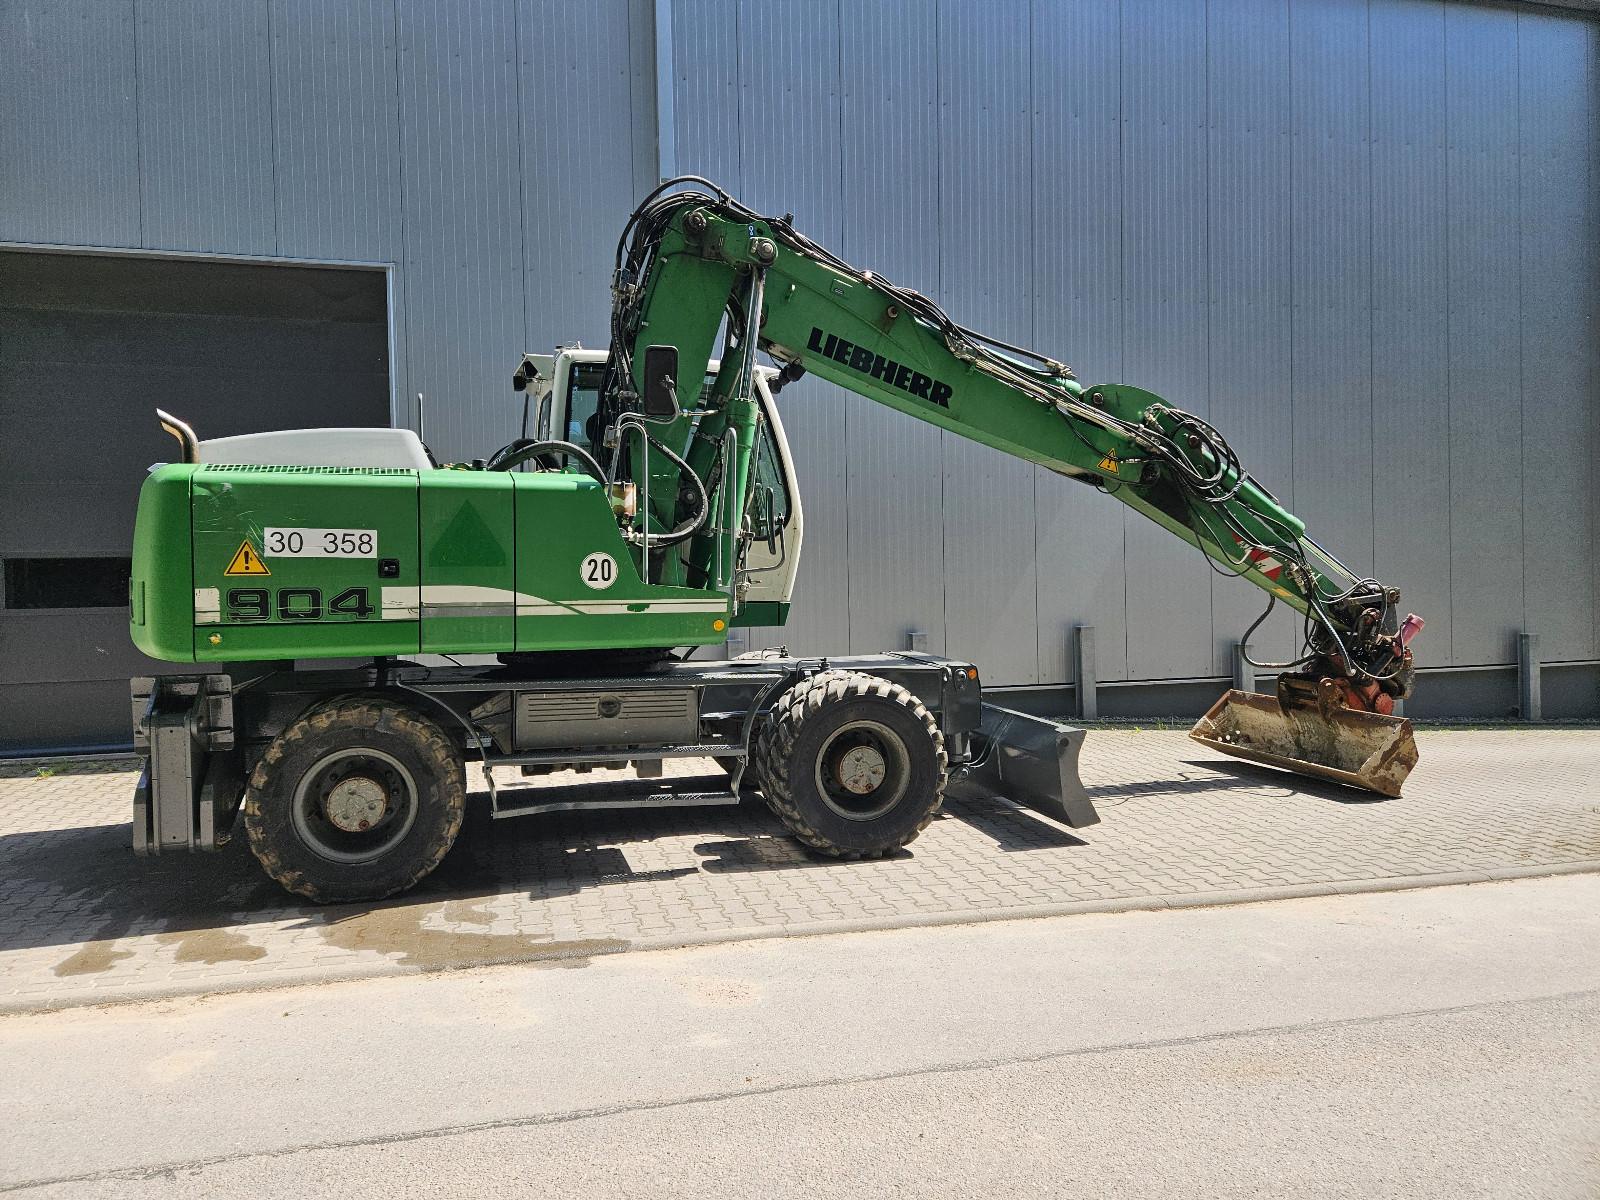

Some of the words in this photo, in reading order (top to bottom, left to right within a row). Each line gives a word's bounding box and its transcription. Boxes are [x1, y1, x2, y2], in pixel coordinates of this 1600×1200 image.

[807, 327, 953, 409] LIEBHERR
[269, 531, 304, 553] 30
[322, 532, 374, 555] 358
[587, 558, 612, 582] 20
[226, 587, 375, 621] 904
